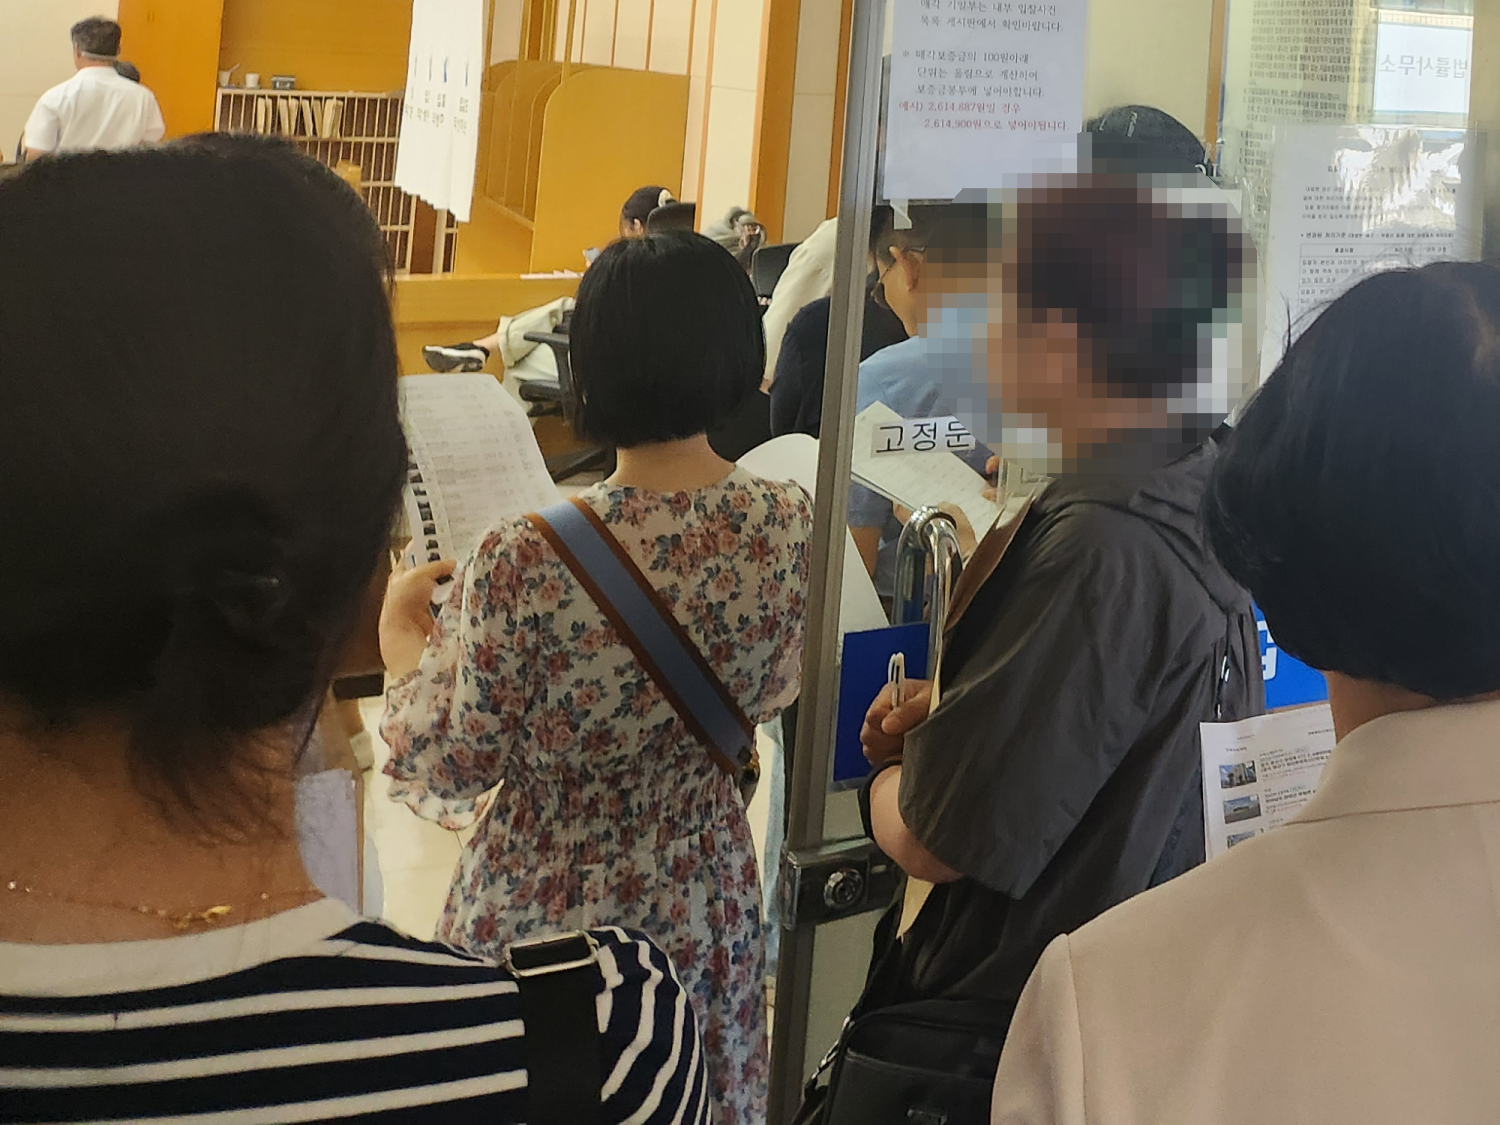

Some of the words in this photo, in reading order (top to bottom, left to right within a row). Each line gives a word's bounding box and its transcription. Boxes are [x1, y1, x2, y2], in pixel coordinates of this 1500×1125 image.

[920, 0, 940, 9] 매각
[992, 2, 1012, 14] 내부
[1017, 3, 1056, 16] 입찰사건
[946, 16, 996, 29] 게시판에서
[915, 49, 977, 62] 매각보증금의
[983, 52, 1029, 64] 100원아래
[917, 66, 948, 79] 단위는
[955, 68, 994, 79] 올림으로
[916, 84, 977, 96] 보증금봉투에
[899, 100, 924, 112] 예시)
[1002, 102, 1021, 114] 경우
[876, 421, 972, 453] 고정문
